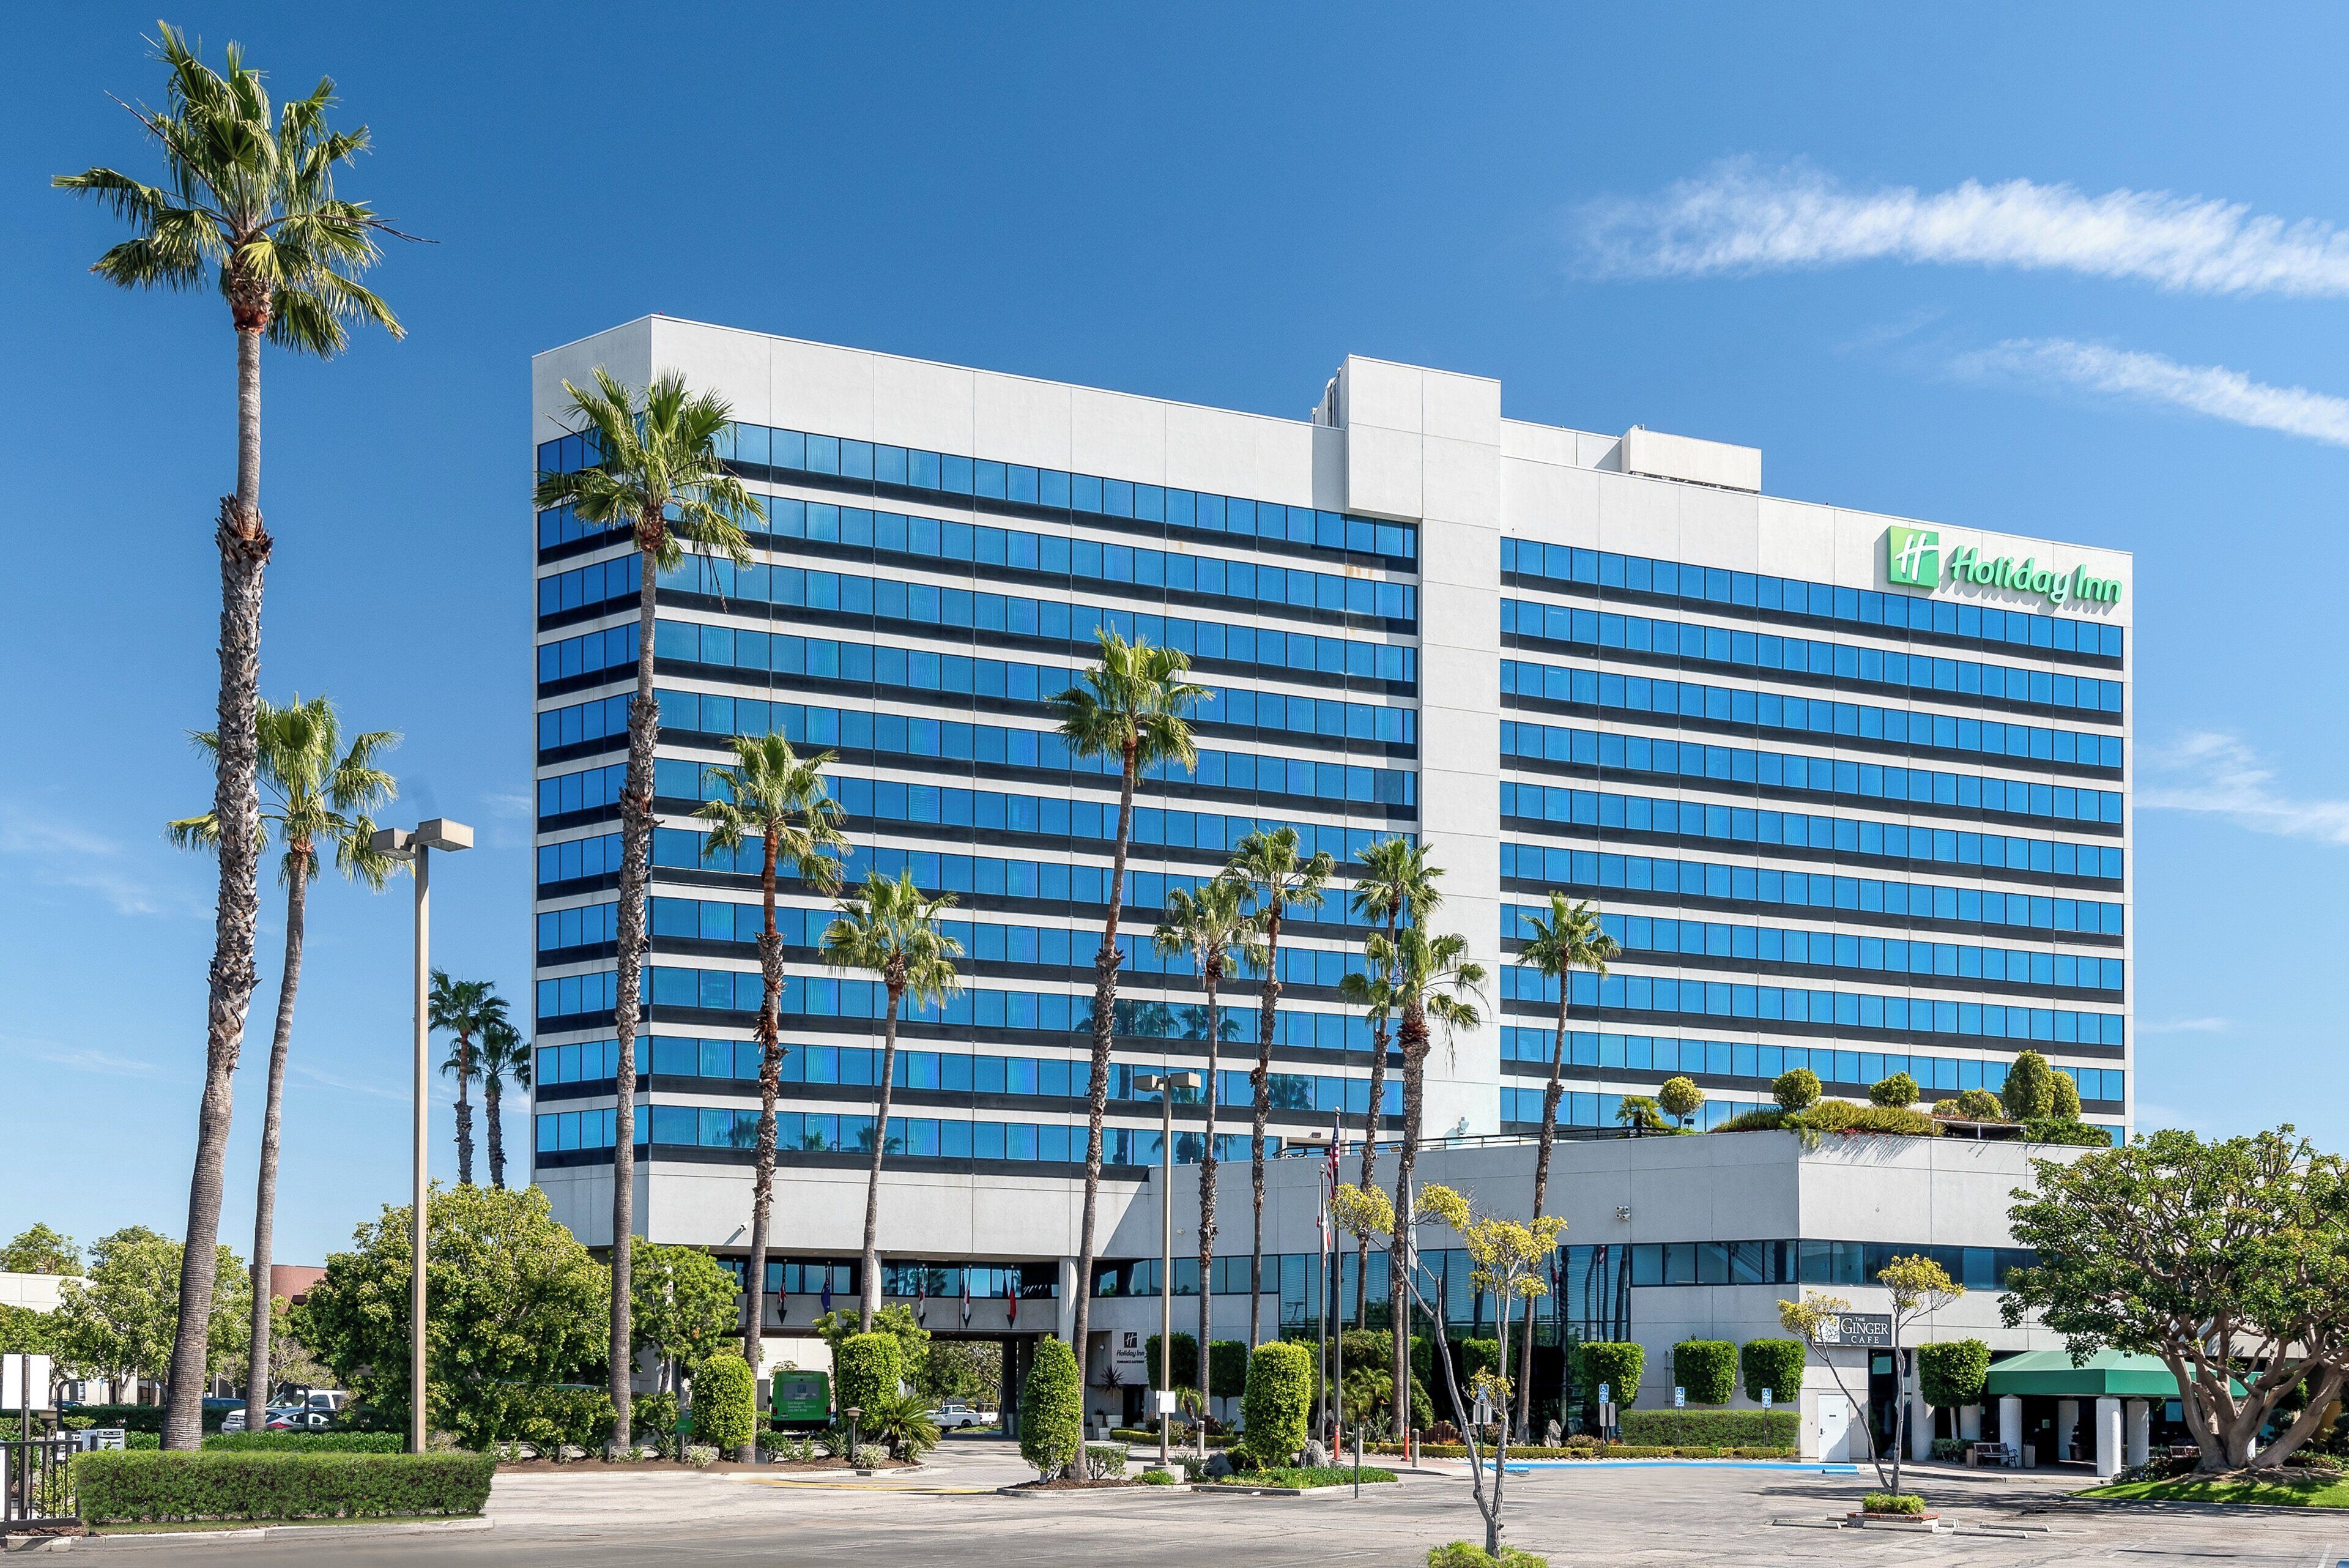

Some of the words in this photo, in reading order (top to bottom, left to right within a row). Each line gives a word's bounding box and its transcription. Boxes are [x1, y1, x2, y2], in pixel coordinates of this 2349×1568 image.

[1895, 533, 1939, 581] H
[1951, 545, 2071, 603] Holiday
[2074, 563, 2122, 603] Inn
[1840, 1317, 1889, 1335] GINGER
[1116, 1349, 1136, 1358] Holiday
